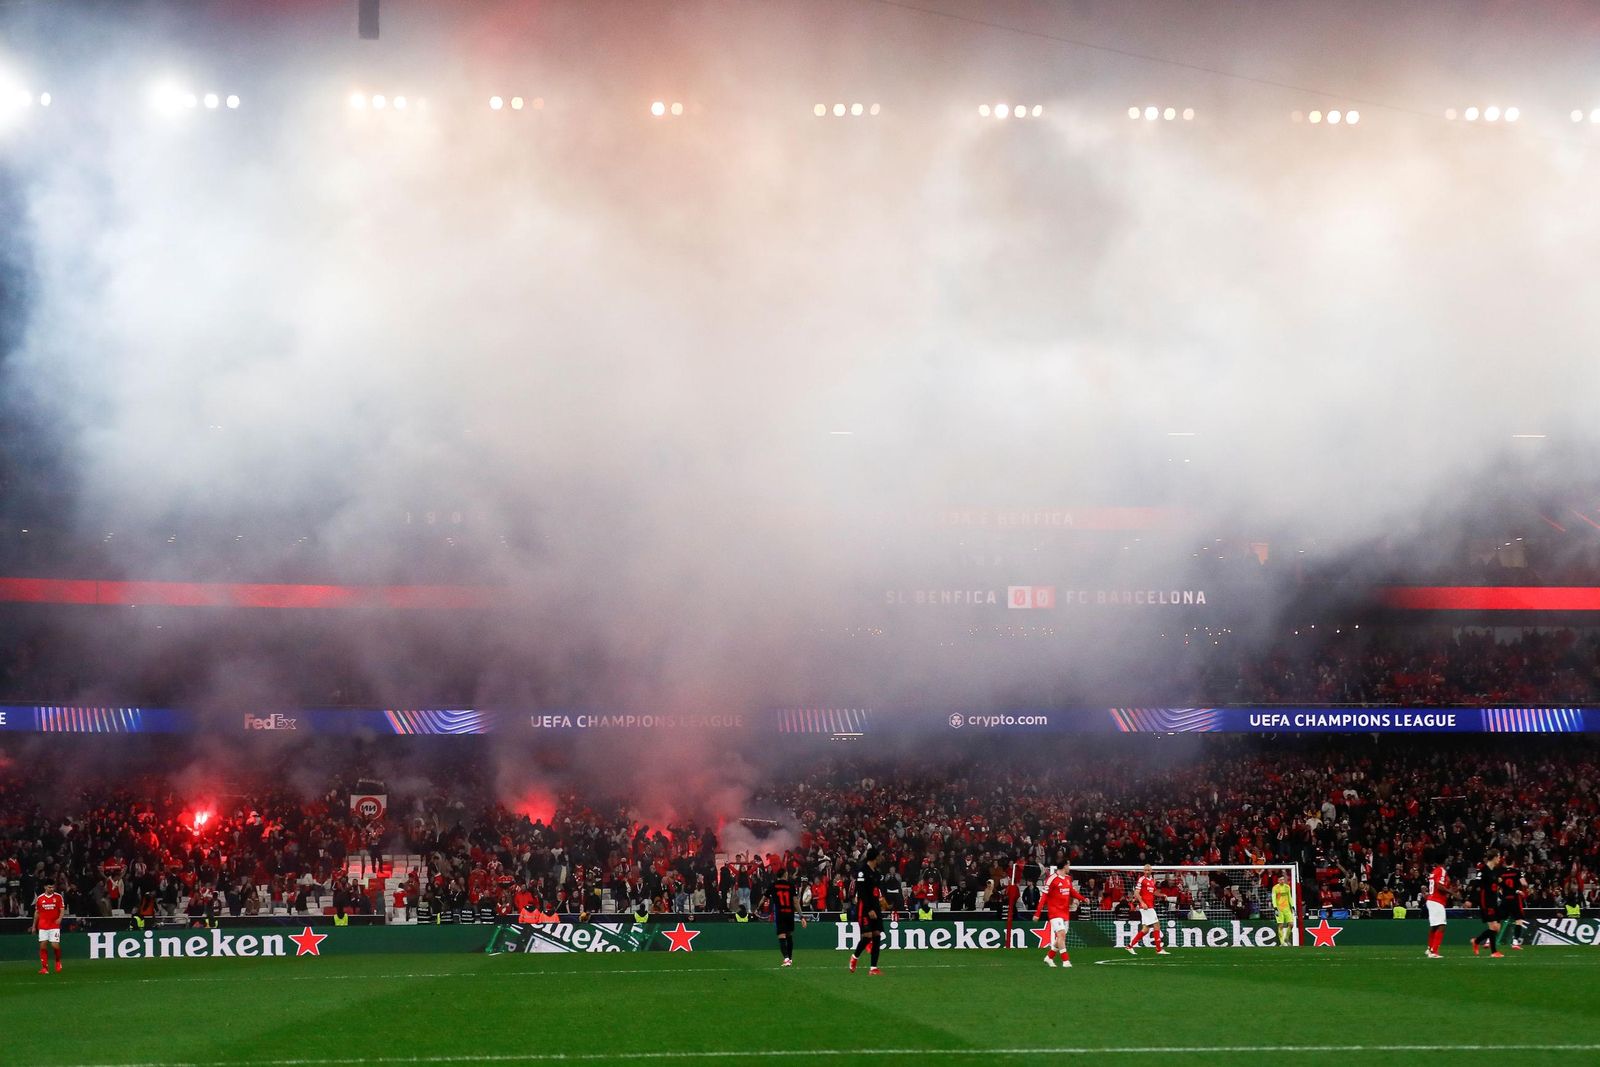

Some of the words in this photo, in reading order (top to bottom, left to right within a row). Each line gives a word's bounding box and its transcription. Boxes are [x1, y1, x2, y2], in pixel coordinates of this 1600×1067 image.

[914, 591, 997, 605] BENFICA
[1013, 590, 1027, 607] 0
[1036, 590, 1049, 607] 0
[1066, 591, 1089, 605] FC
[1097, 591, 1207, 605] BARCELONA
[244, 713, 297, 730] FedEx
[530, 715, 572, 728] UEFA
[576, 715, 676, 728] CHAMPIONS
[679, 715, 744, 728] LEAGUE
[968, 713, 1048, 728] crypto.com
[1249, 714, 1290, 727] UEFA
[1294, 714, 1391, 727] CHAMPIONS
[1394, 714, 1457, 727] LEAGUE
[777, 891, 792, 906] 11
[88, 930, 287, 959] Heineken
